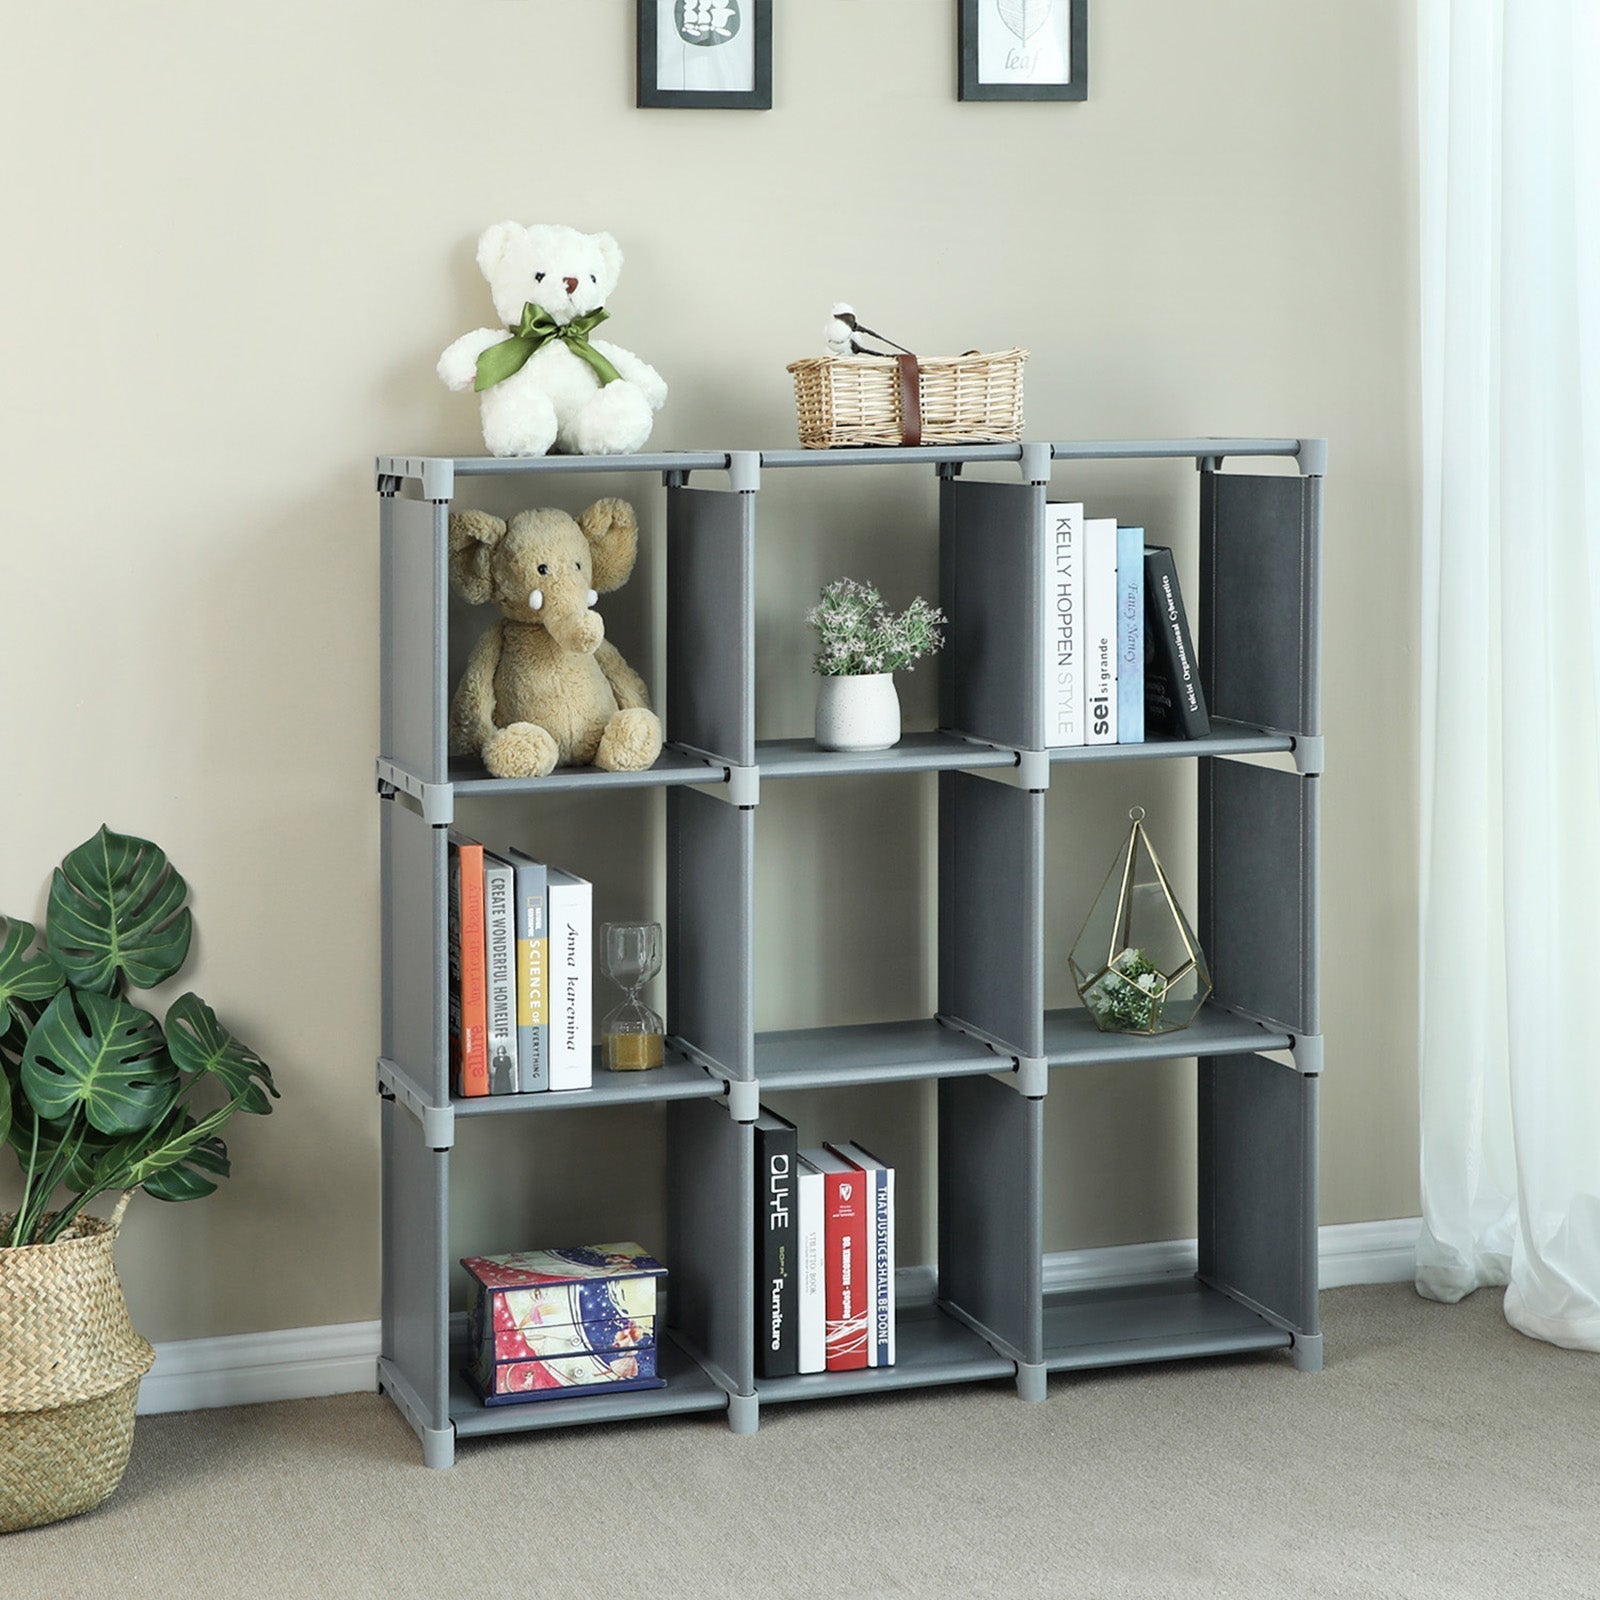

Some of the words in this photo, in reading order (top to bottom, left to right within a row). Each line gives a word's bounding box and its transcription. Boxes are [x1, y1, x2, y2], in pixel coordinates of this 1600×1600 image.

[1005, 47, 1042, 78] leaf
[1056, 518, 1072, 577] KELLY
[1124, 583, 1139, 622] Fancy
[1162, 575, 1179, 621] Cybernetics
[1057, 583, 1073, 666] HOPPEN
[1123, 623, 1139, 664] Nancy
[1100, 638, 1111, 680] grande
[1172, 624, 1192, 681] Organizational
[1058, 672, 1074, 734] STYLE
[1100, 682, 1109, 694] si
[1089, 696, 1109, 736] sei
[465, 883, 482, 930] Beauty
[491, 878, 506, 916] CREATE
[492, 917, 508, 984] WONDERFUL
[567, 923, 579, 967] Anna
[466, 934, 482, 1007] American
[529, 939, 542, 1009] SCIENCE
[494, 986, 509, 1039] HOMELIFE
[532, 1012, 541, 1024] OF
[466, 1024, 485, 1079] allure
[533, 1026, 541, 1080] EVERYTHING
[877, 1186, 888, 1216] THAT
[877, 1217, 888, 1260] JUSTICE
[808, 1275, 816, 1296] BOOK
[877, 1262, 888, 1295] SHALL
[771, 1278, 784, 1351] Furniture
[877, 1298, 888, 1311] BE
[877, 1314, 888, 1345] DONE
